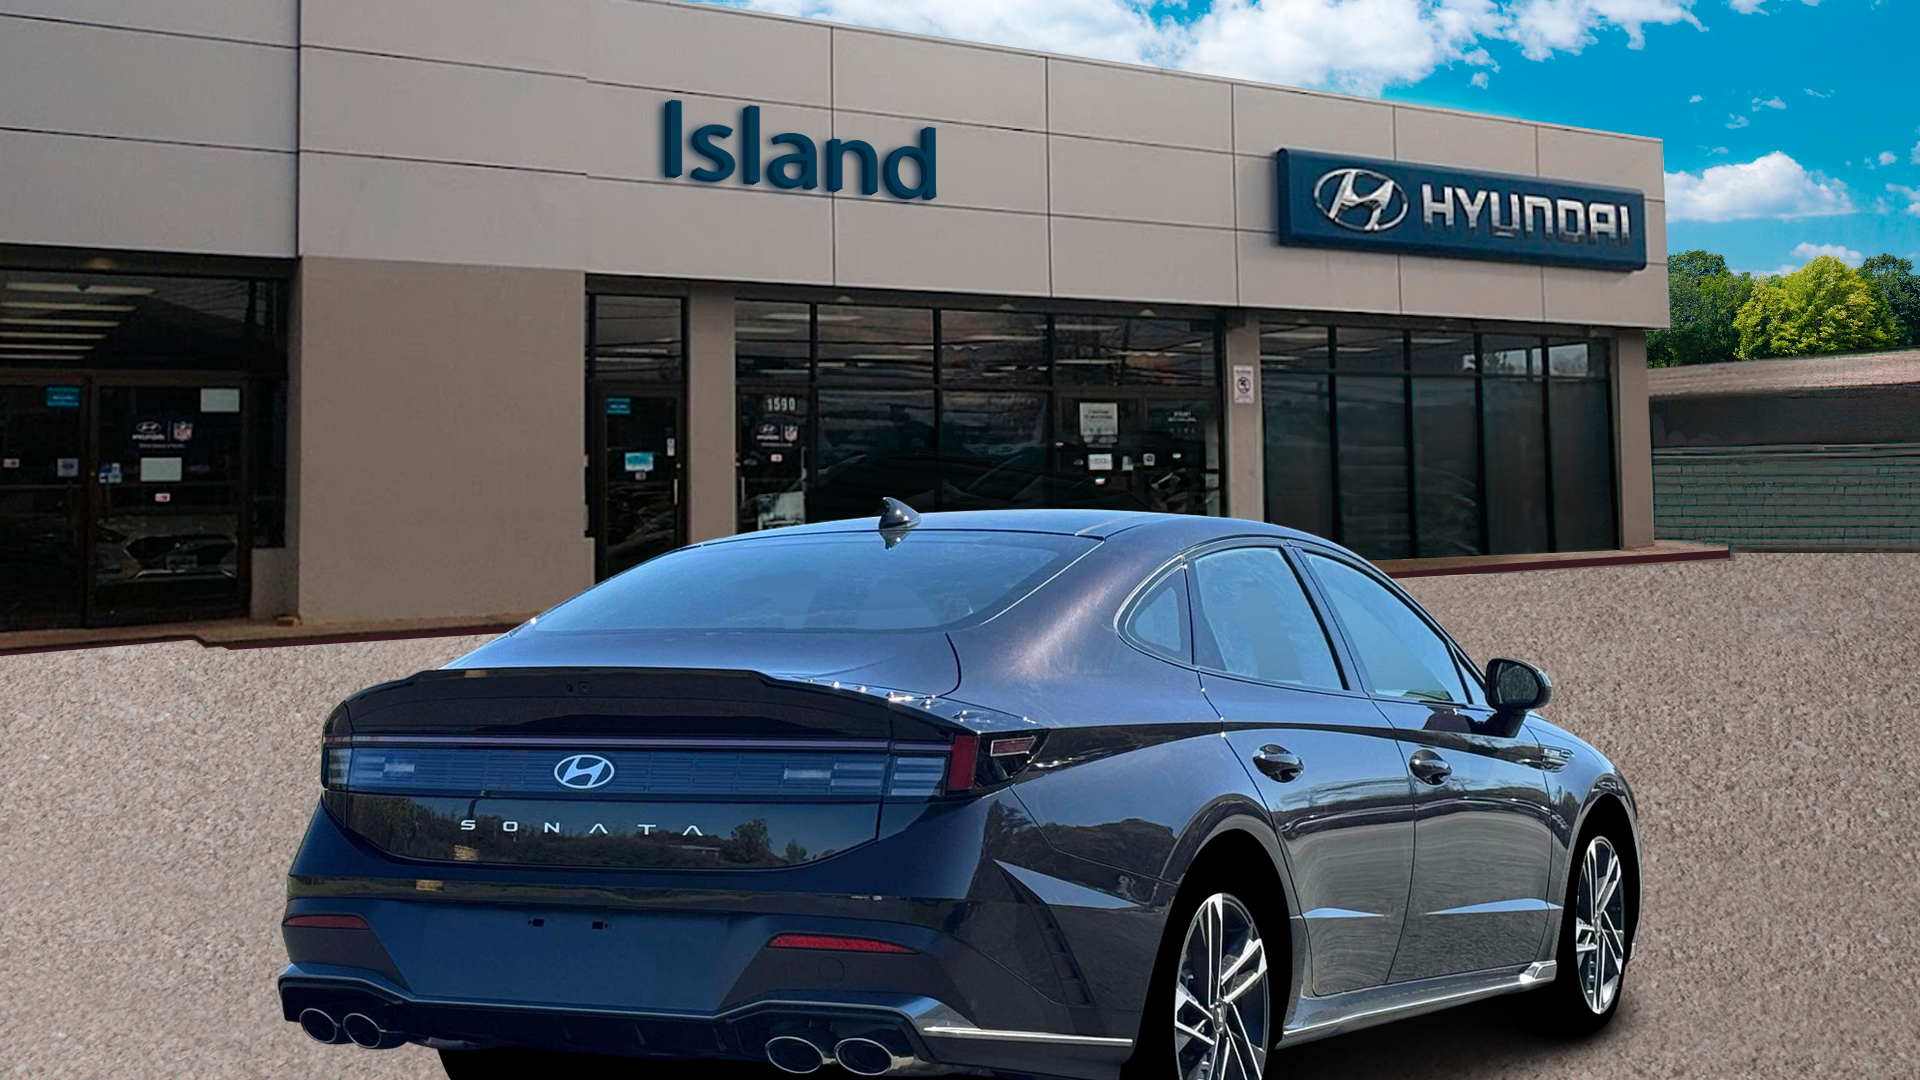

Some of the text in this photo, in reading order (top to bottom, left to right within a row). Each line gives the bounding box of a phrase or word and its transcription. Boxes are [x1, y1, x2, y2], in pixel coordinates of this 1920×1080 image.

[664, 99, 937, 201] Island
[1422, 183, 1631, 245] HYUNDAI
[767, 397, 796, 411] 1590
[460, 819, 703, 837] SONATA
